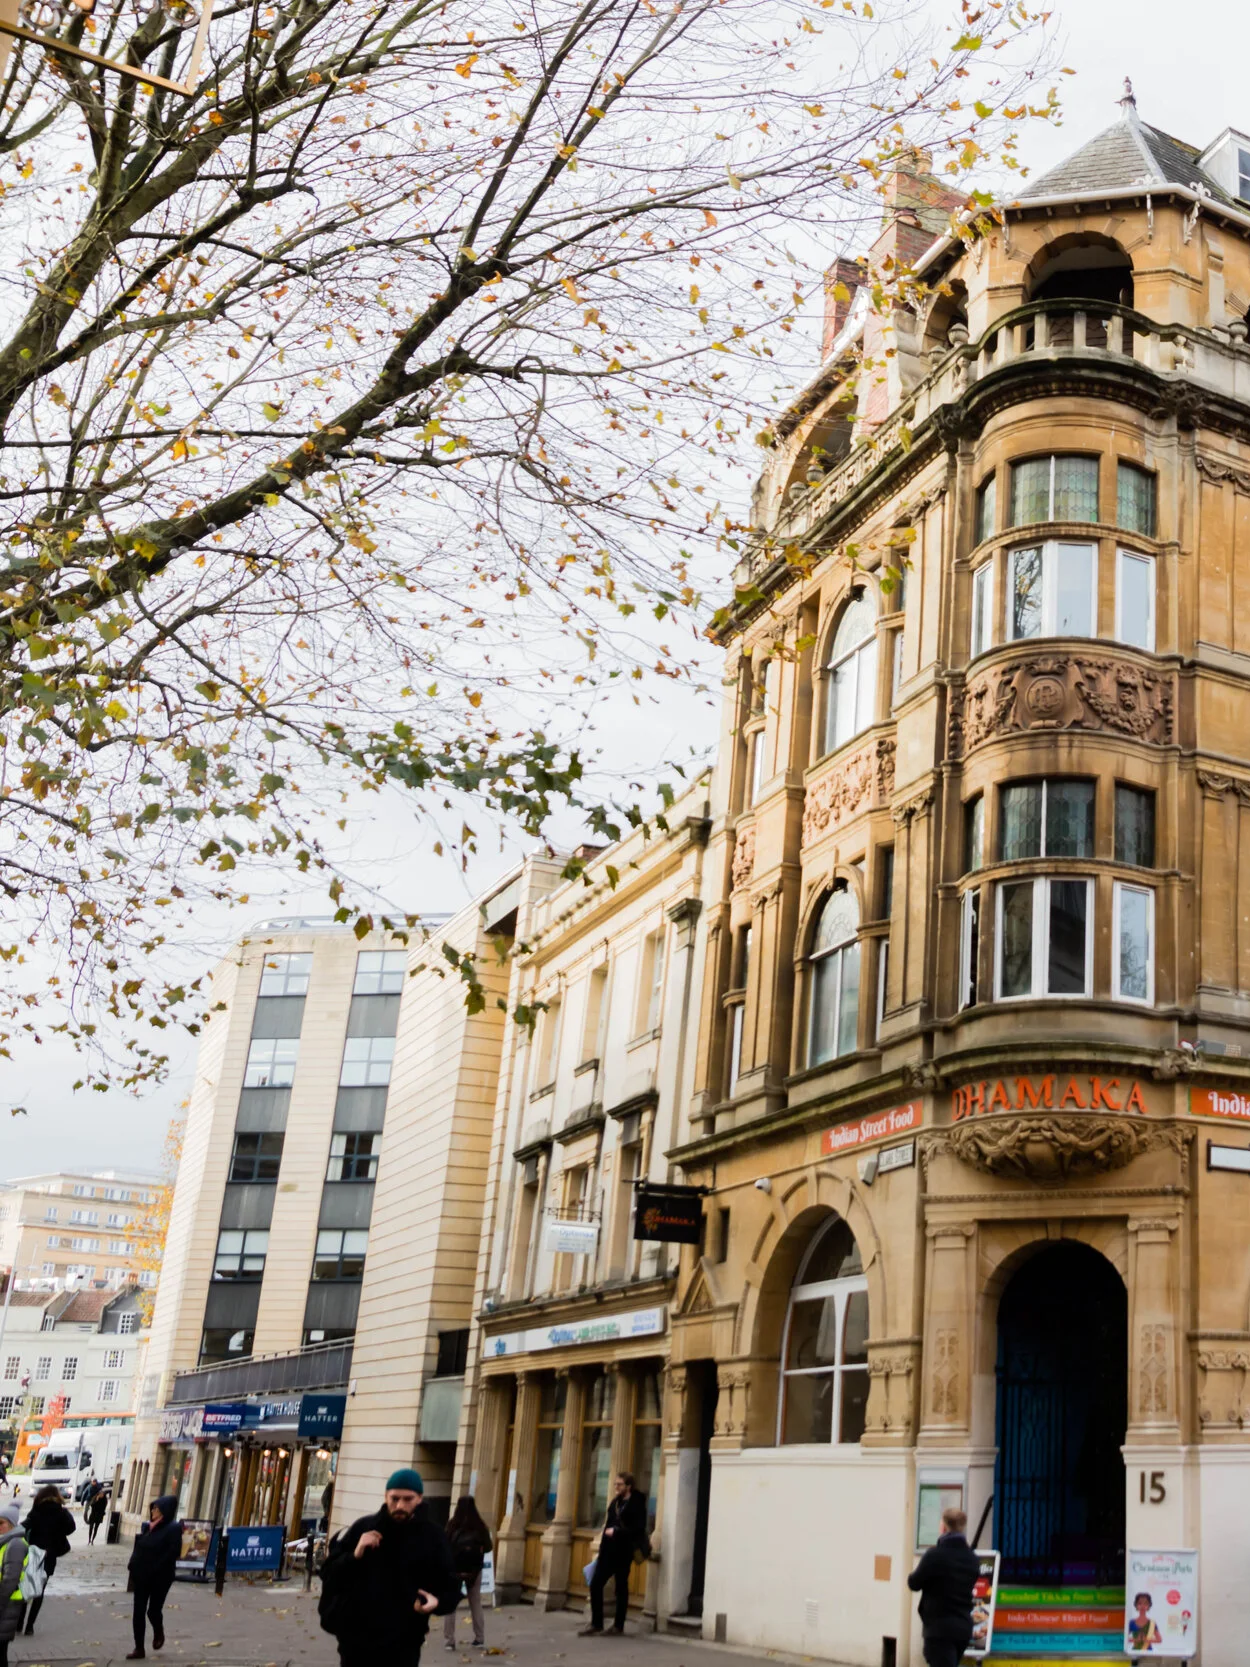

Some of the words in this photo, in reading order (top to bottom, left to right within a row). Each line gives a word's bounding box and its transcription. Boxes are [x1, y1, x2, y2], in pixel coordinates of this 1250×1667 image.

[952, 1073, 1149, 1121] DHAMAKA
[829, 1126, 859, 1149] Indian
[860, 1117, 887, 1142] Street
[888, 1105, 914, 1131] Food
[205, 1414, 242, 1422] BETFRED
[304, 1415, 338, 1423] HATTER
[1140, 1471, 1166, 1504] 15
[231, 1547, 273, 1557] HATTER
